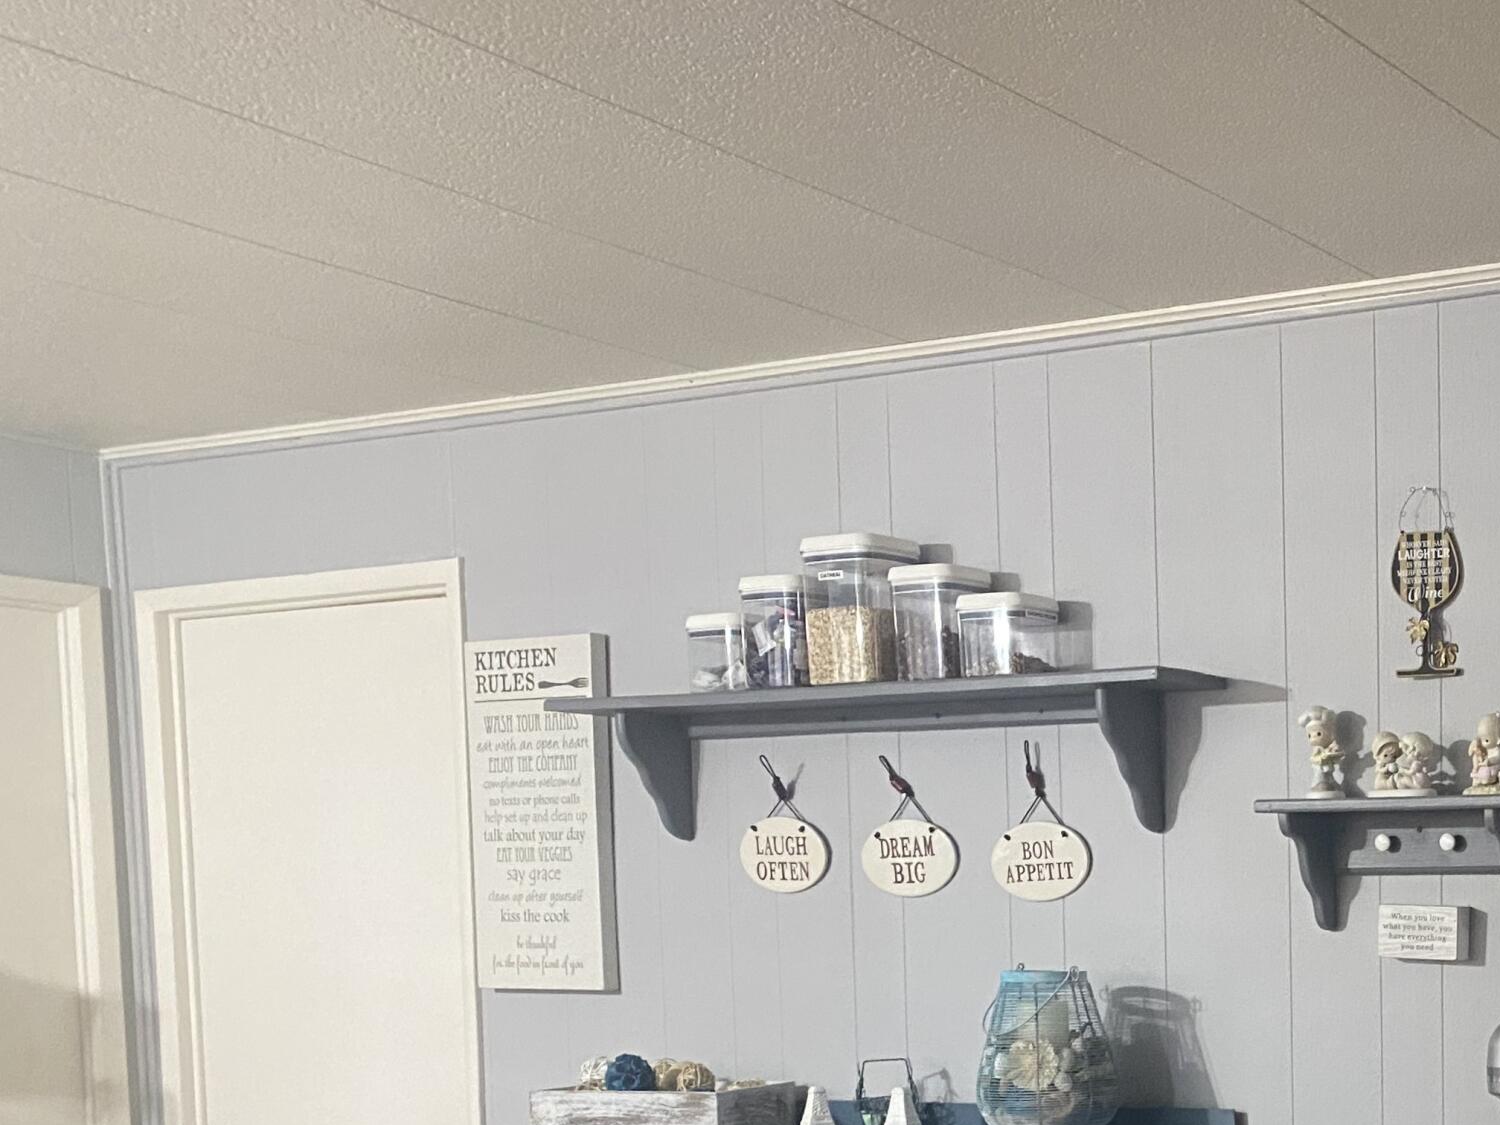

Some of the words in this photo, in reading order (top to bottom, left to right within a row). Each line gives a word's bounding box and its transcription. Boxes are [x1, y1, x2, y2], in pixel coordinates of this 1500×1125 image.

[1398, 548, 1450, 560] LAUGHTER
[1408, 584, 1444, 602] Wine
[474, 648, 557, 671] KITCHEN
[476, 672, 535, 694] RULES
[483, 715, 513, 734] WASH
[516, 713, 542, 732] YOUR
[495, 738, 516, 752] with
[536, 740, 560, 755] open
[562, 735, 589, 748] heart
[488, 757, 514, 773] ENJOY
[517, 756, 534, 772] THE
[536, 754, 577, 771] COMPANY
[560, 793, 580, 804] calls
[576, 812, 588, 824] up
[484, 829, 503, 842] talk
[506, 828, 536, 842] about
[538, 831, 563, 844] your
[566, 827, 586, 844] day
[755, 835, 808, 857] LAUGH
[879, 835, 936, 859] DREAM
[1021, 840, 1055, 861] BON
[506, 870, 525, 885] say
[529, 868, 561, 886] grace
[756, 860, 810, 881] OFTEN
[892, 862, 927, 884] BIG
[1006, 861, 1074, 884] APPETIT
[500, 909, 520, 922] kiss
[523, 908, 541, 922] the
[543, 908, 570, 922] cook
[1391, 912, 1413, 921] When
[1414, 914, 1427, 922] you
[1429, 913, 1445, 922] love
[1388, 932, 1405, 940] have
[1407, 934, 1447, 943] everything
[1439, 926, 1453, 934] you
